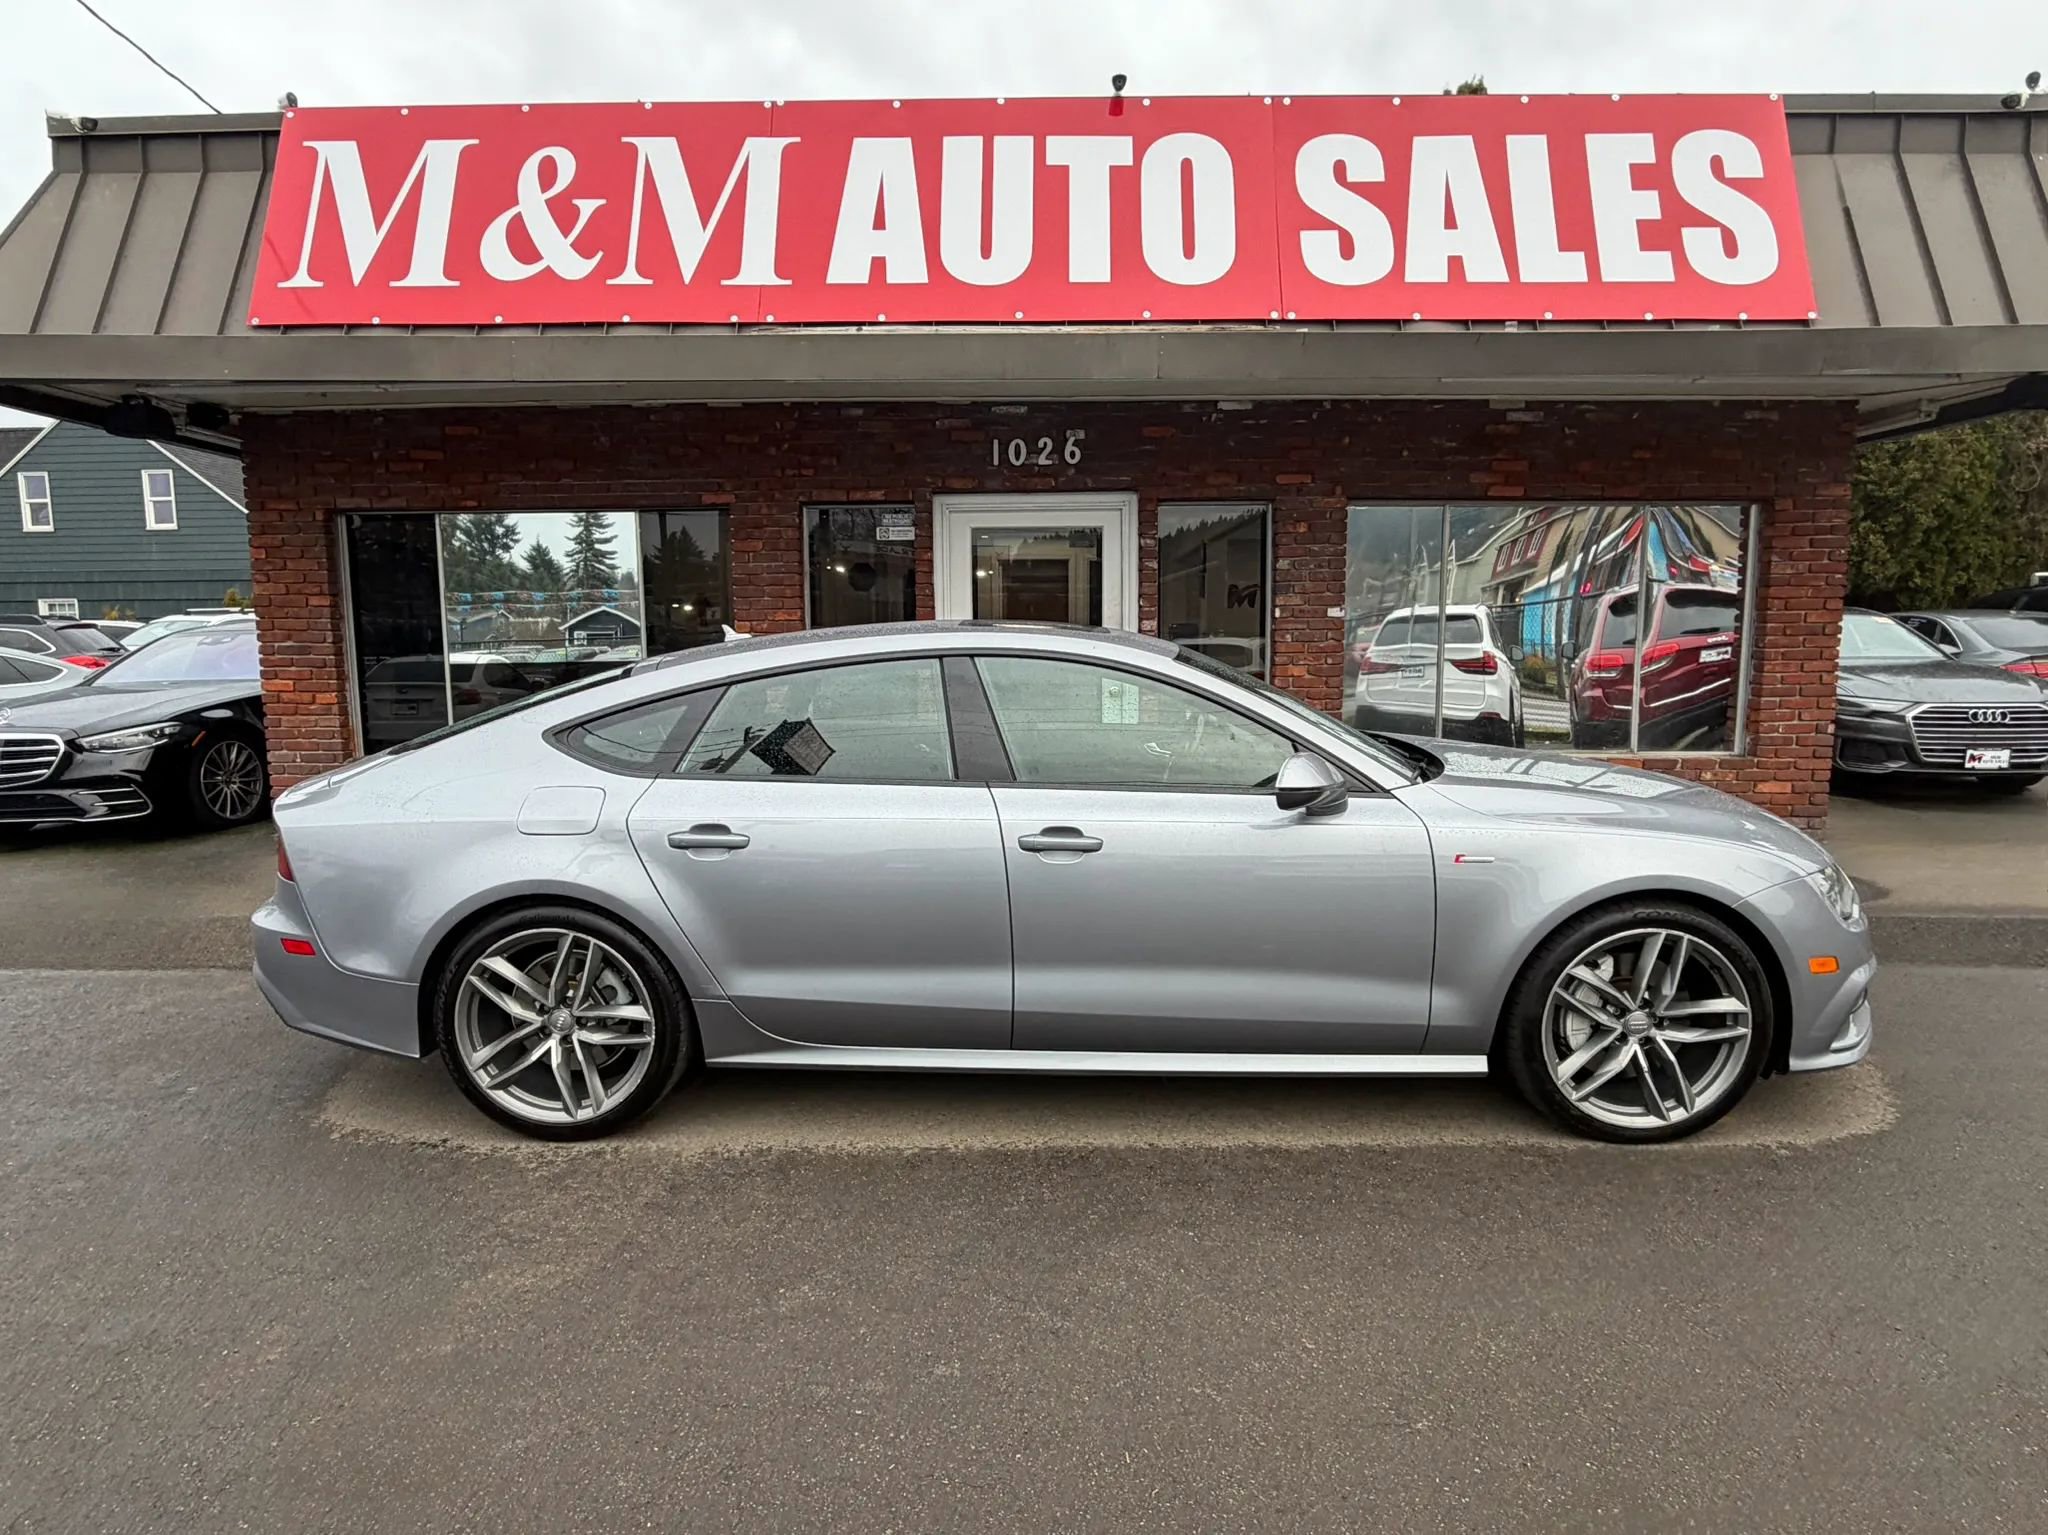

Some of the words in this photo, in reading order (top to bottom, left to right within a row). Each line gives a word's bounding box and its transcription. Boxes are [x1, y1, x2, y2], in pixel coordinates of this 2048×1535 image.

[277, 137, 800, 289] M&M
[826, 136, 1235, 285] AUTO
[1295, 129, 1780, 285] SALES
[992, 436, 1082, 466] 1026
